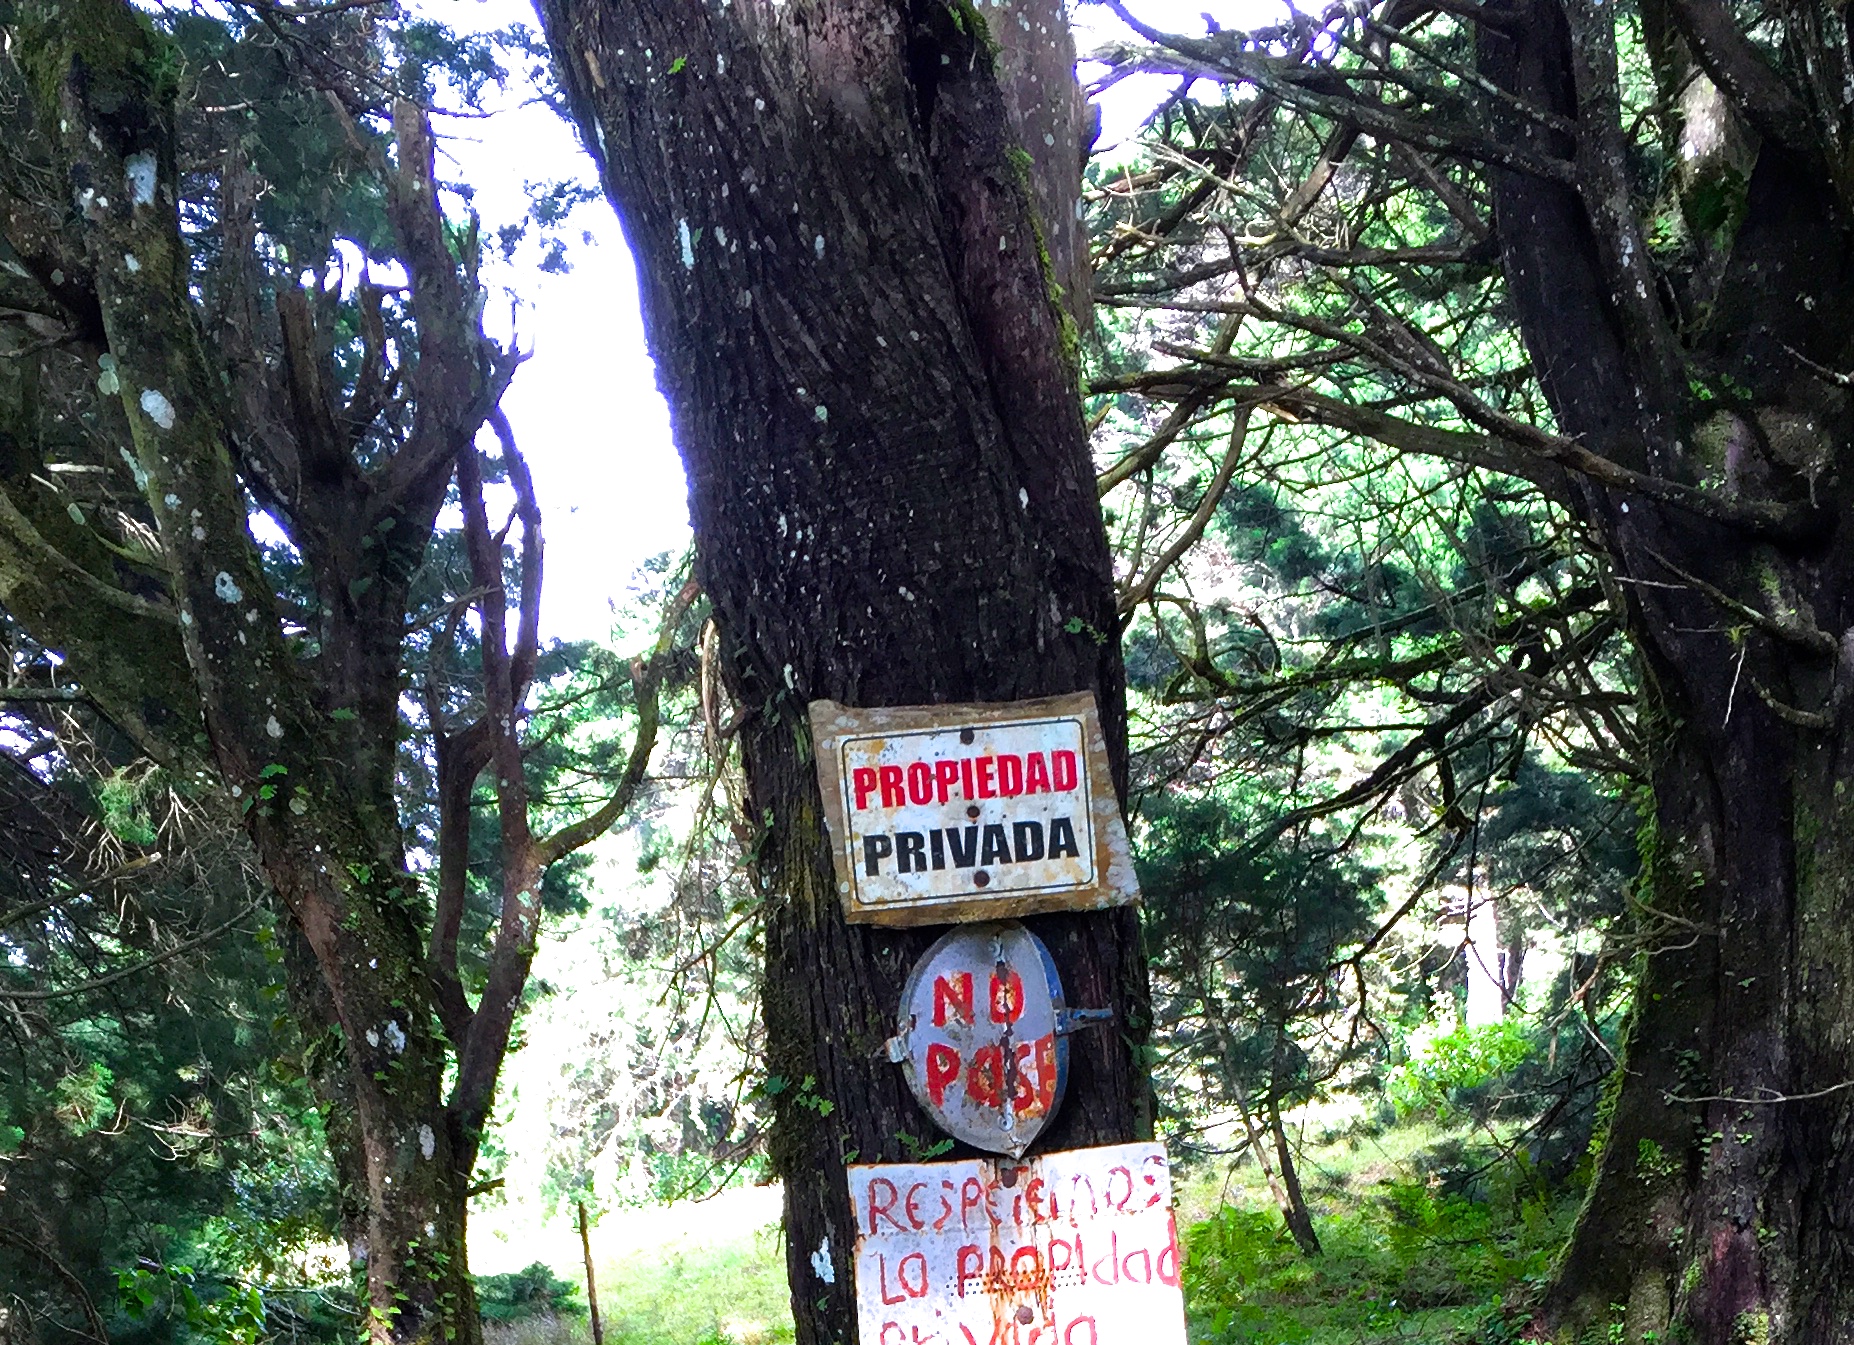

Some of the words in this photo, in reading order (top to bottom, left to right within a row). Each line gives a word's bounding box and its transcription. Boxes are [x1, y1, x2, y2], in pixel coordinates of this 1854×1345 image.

[853, 750, 1078, 810] PROPIEDAD
[863, 817, 1080, 877] PRIVADA
[932, 971, 1024, 1027] NO
